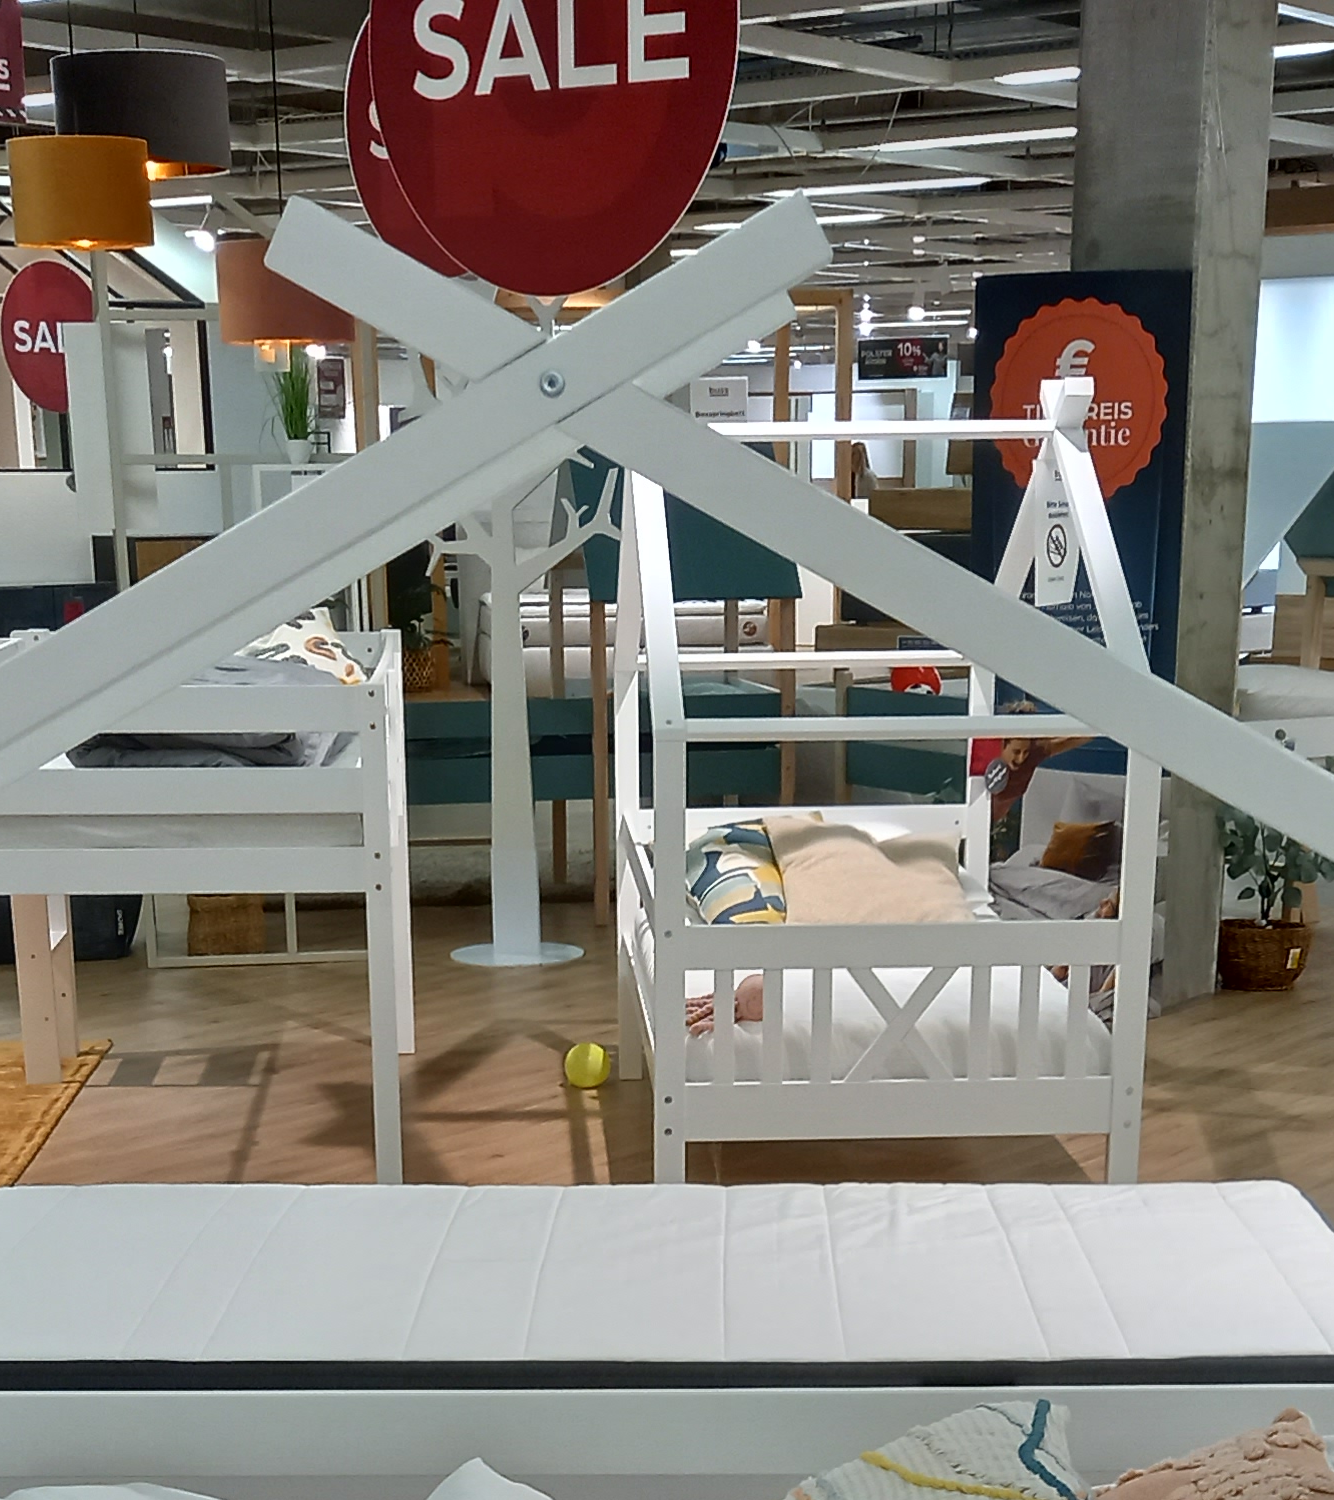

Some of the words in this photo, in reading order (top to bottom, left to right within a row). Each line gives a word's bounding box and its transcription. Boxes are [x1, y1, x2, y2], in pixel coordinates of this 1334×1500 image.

[413, 0, 690, 100] SALE
[13, 320, 65, 353] SAL
[897, 342, 921, 356] 10%
